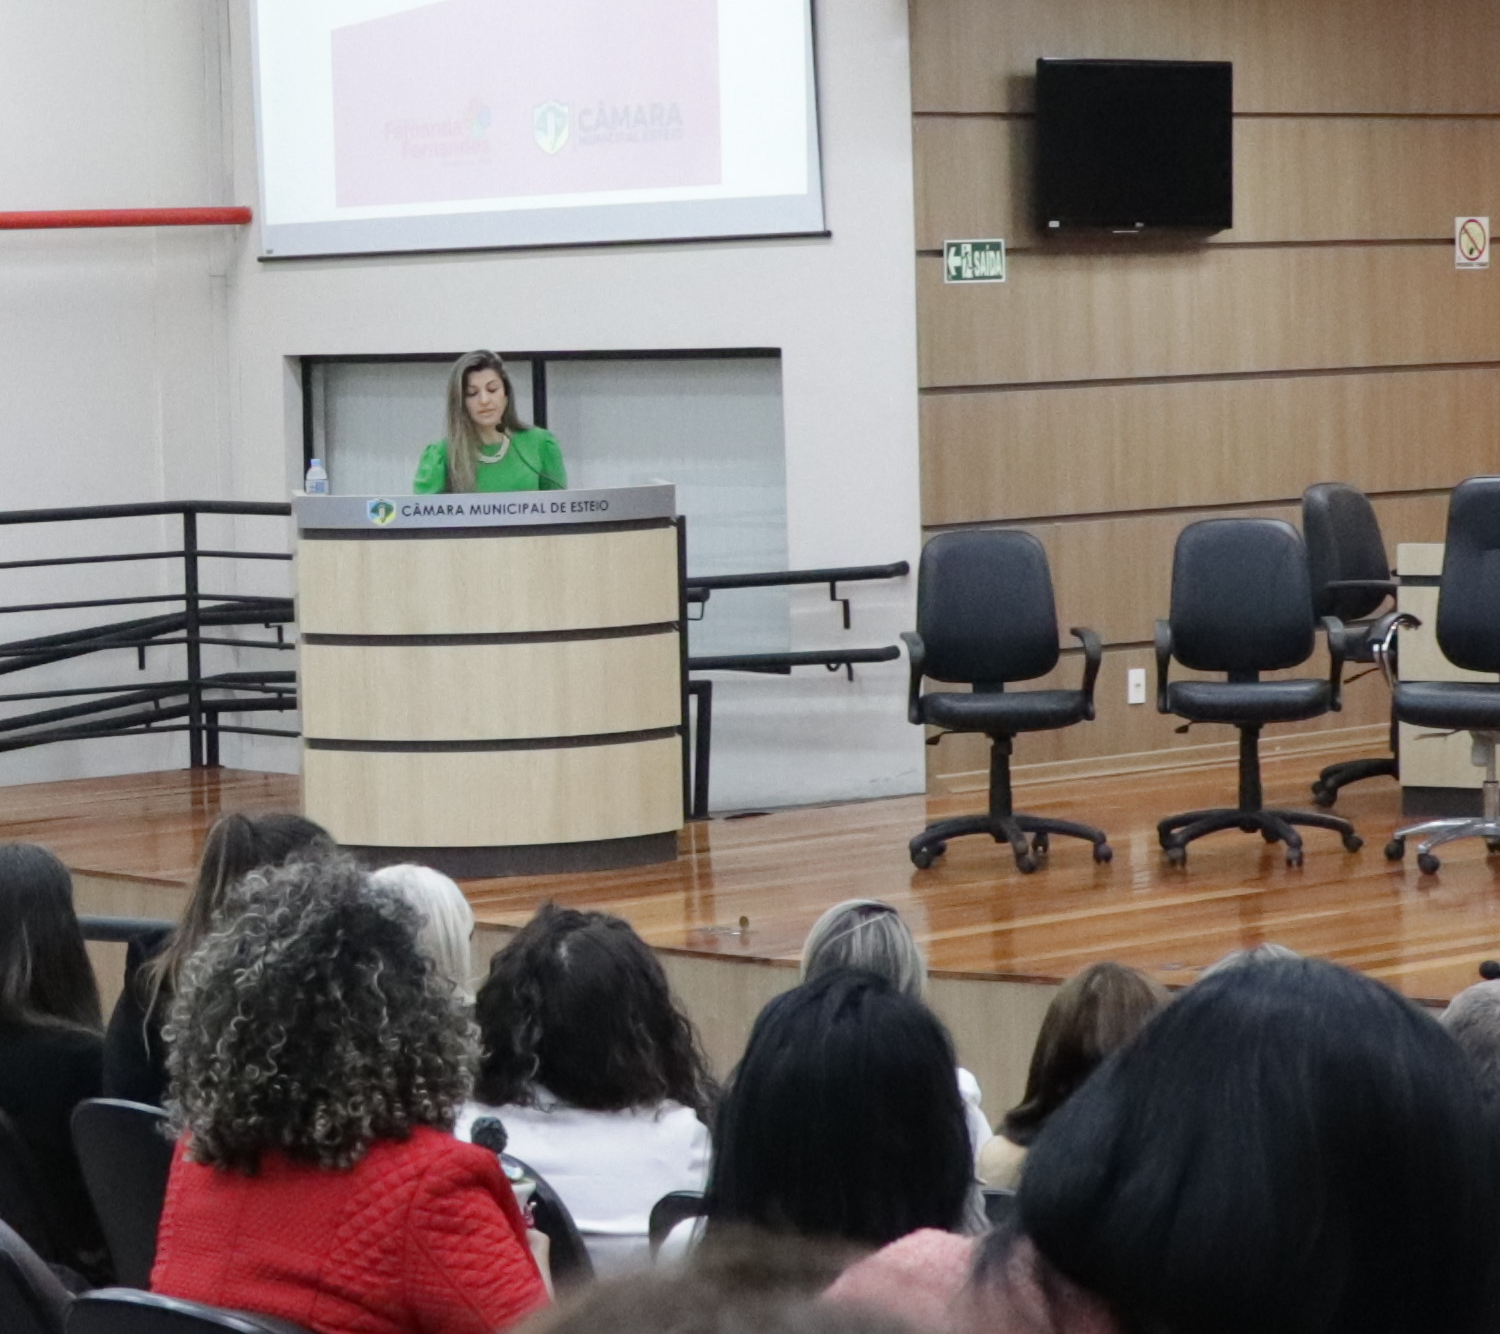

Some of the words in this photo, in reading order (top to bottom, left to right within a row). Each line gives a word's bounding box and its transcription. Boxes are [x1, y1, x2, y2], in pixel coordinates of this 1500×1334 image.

[578, 99, 684, 133] CÂMARA
[973, 244, 1003, 277] SAÍDA
[401, 502, 465, 517] CÂMARA
[469, 502, 545, 515] MUNICIPAL
[550, 501, 567, 514] DE
[570, 499, 609, 513] ESTEIO
